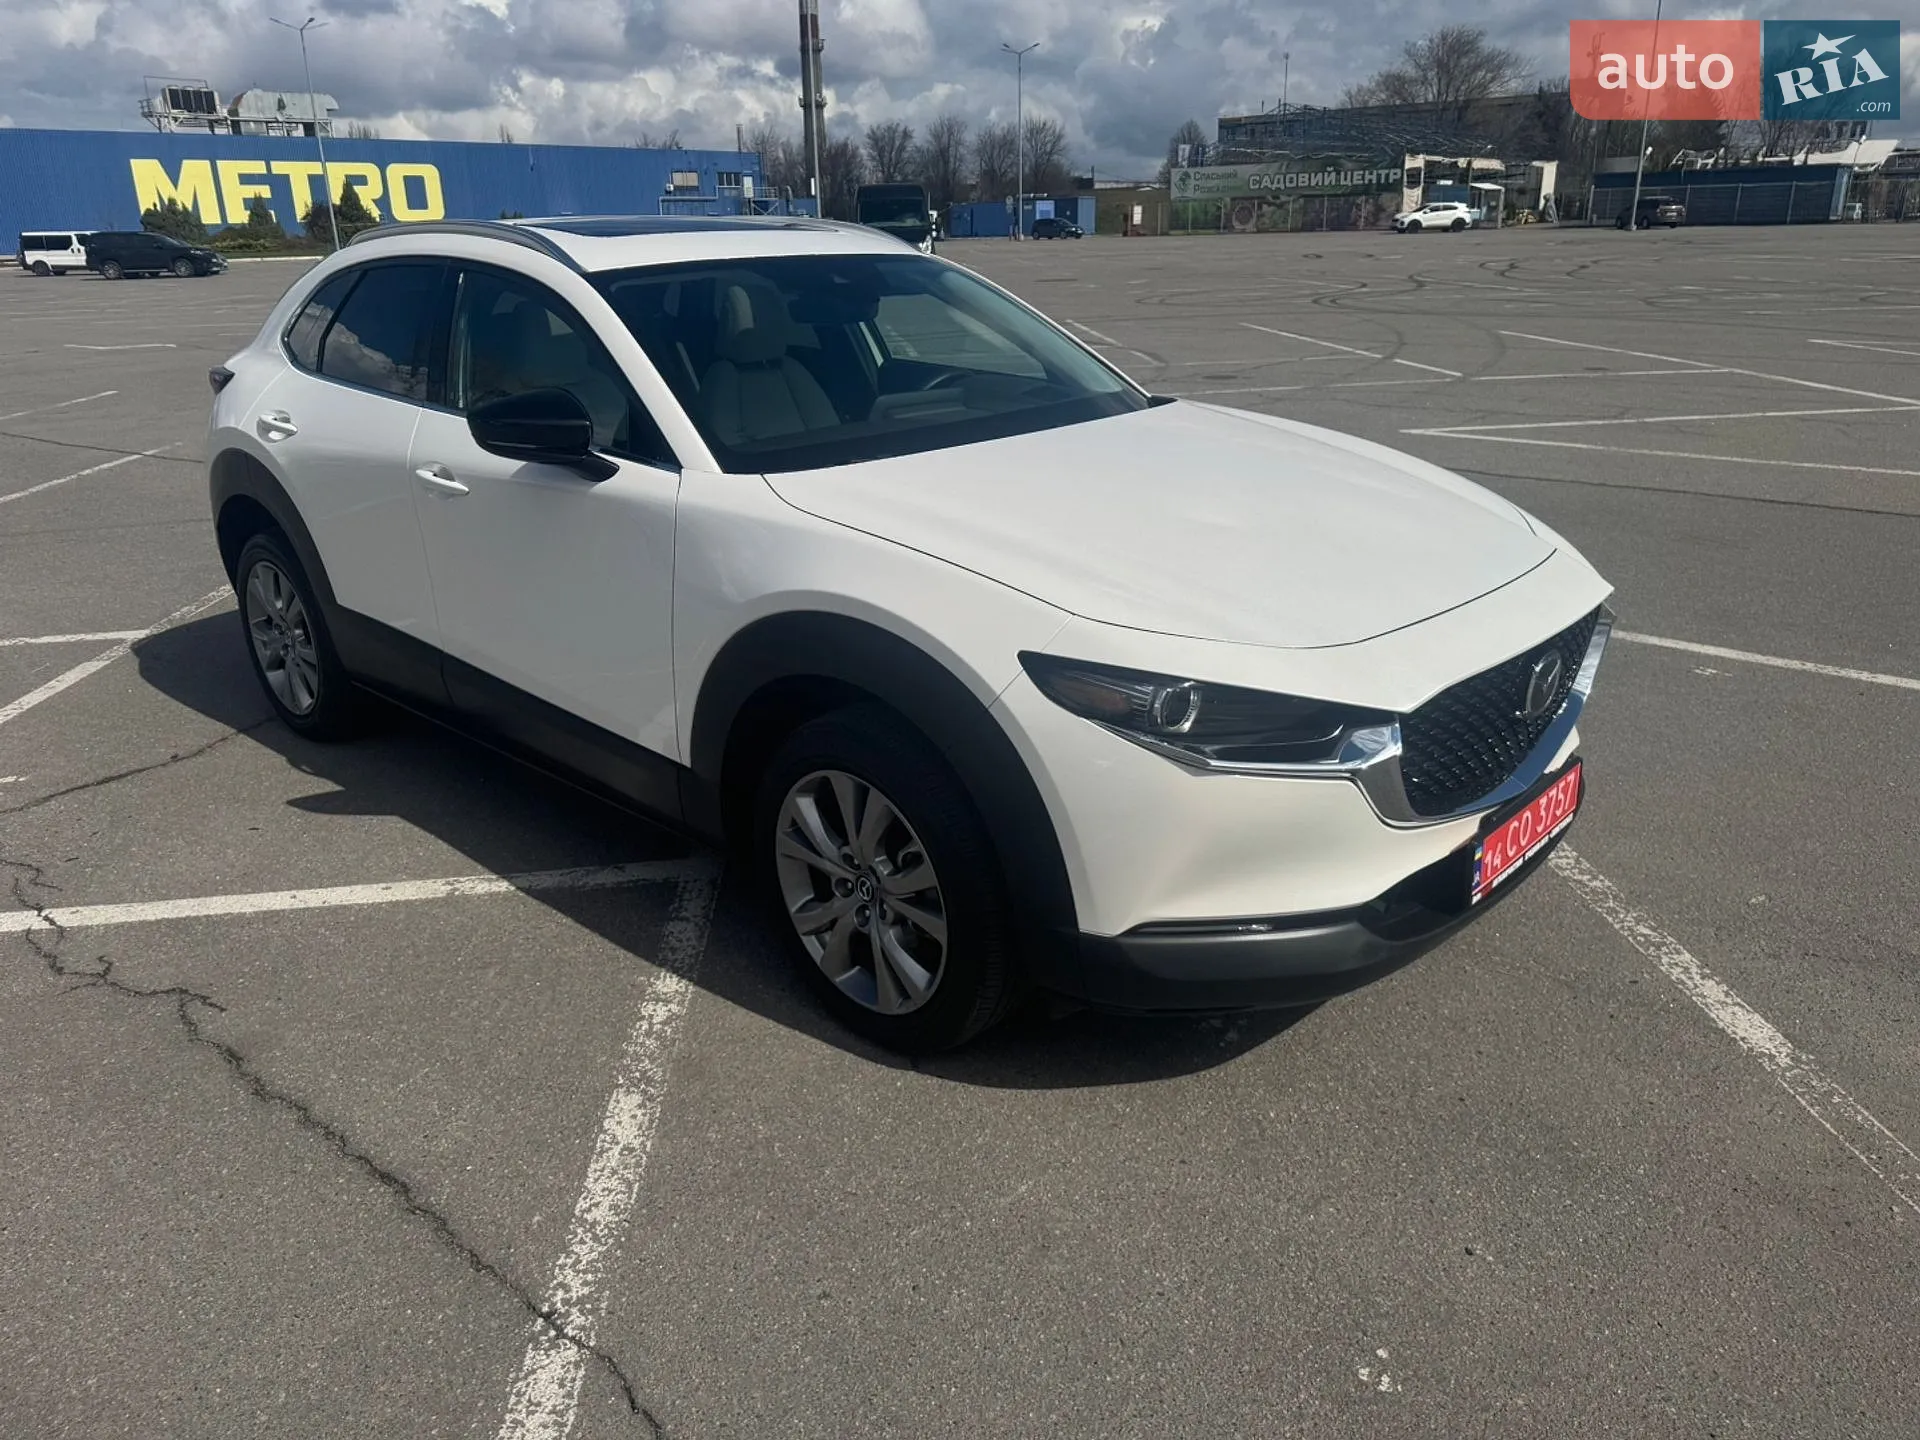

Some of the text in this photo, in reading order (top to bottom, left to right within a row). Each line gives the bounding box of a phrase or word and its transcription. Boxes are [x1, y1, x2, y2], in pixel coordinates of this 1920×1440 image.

[130, 158, 445, 224] METRO
[1249, 167, 1336, 191] САДОВИЙ
[1340, 168, 1402, 186] ЦЕНТР
[1484, 842, 1502, 878] 14
[1536, 771, 1575, 833] 3757
